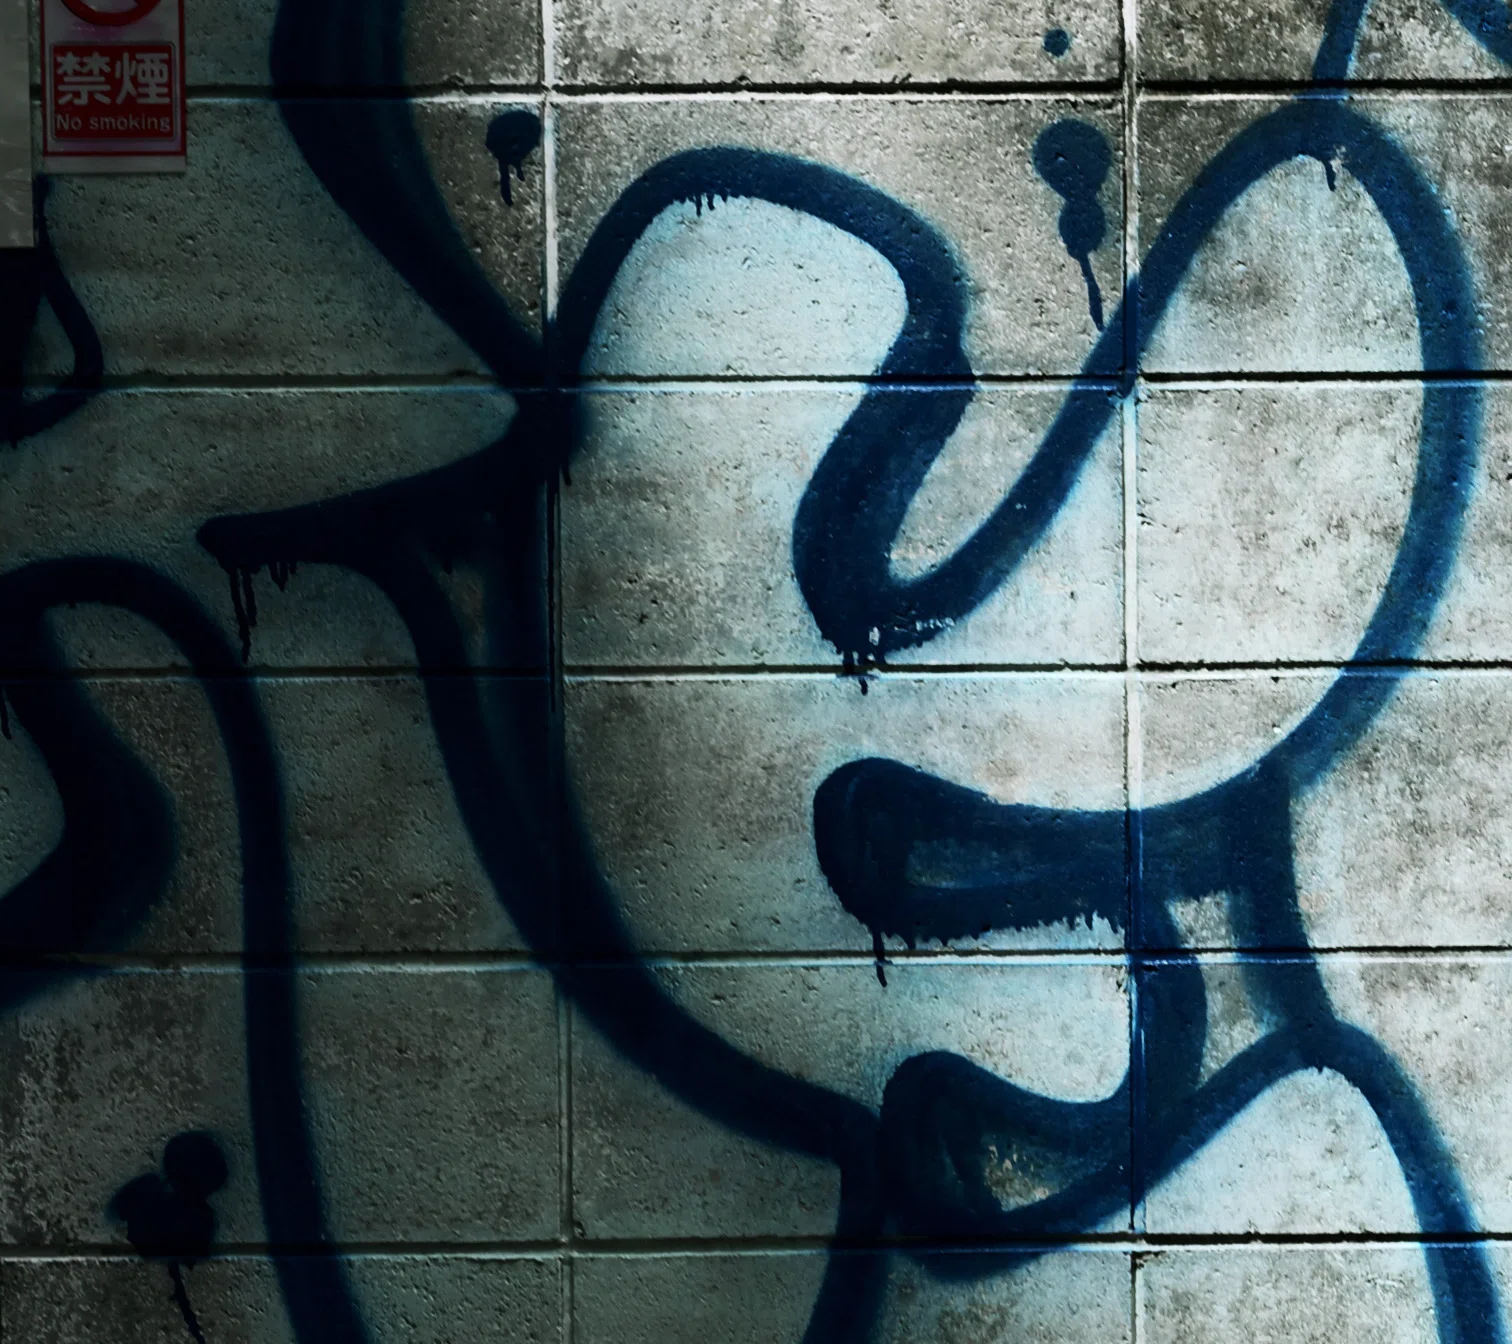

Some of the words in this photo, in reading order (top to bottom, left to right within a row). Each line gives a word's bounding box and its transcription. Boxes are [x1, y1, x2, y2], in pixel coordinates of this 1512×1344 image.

[57, 50, 171, 106] 禁煙
[55, 114, 83, 132] No
[89, 112, 172, 135] smoking
